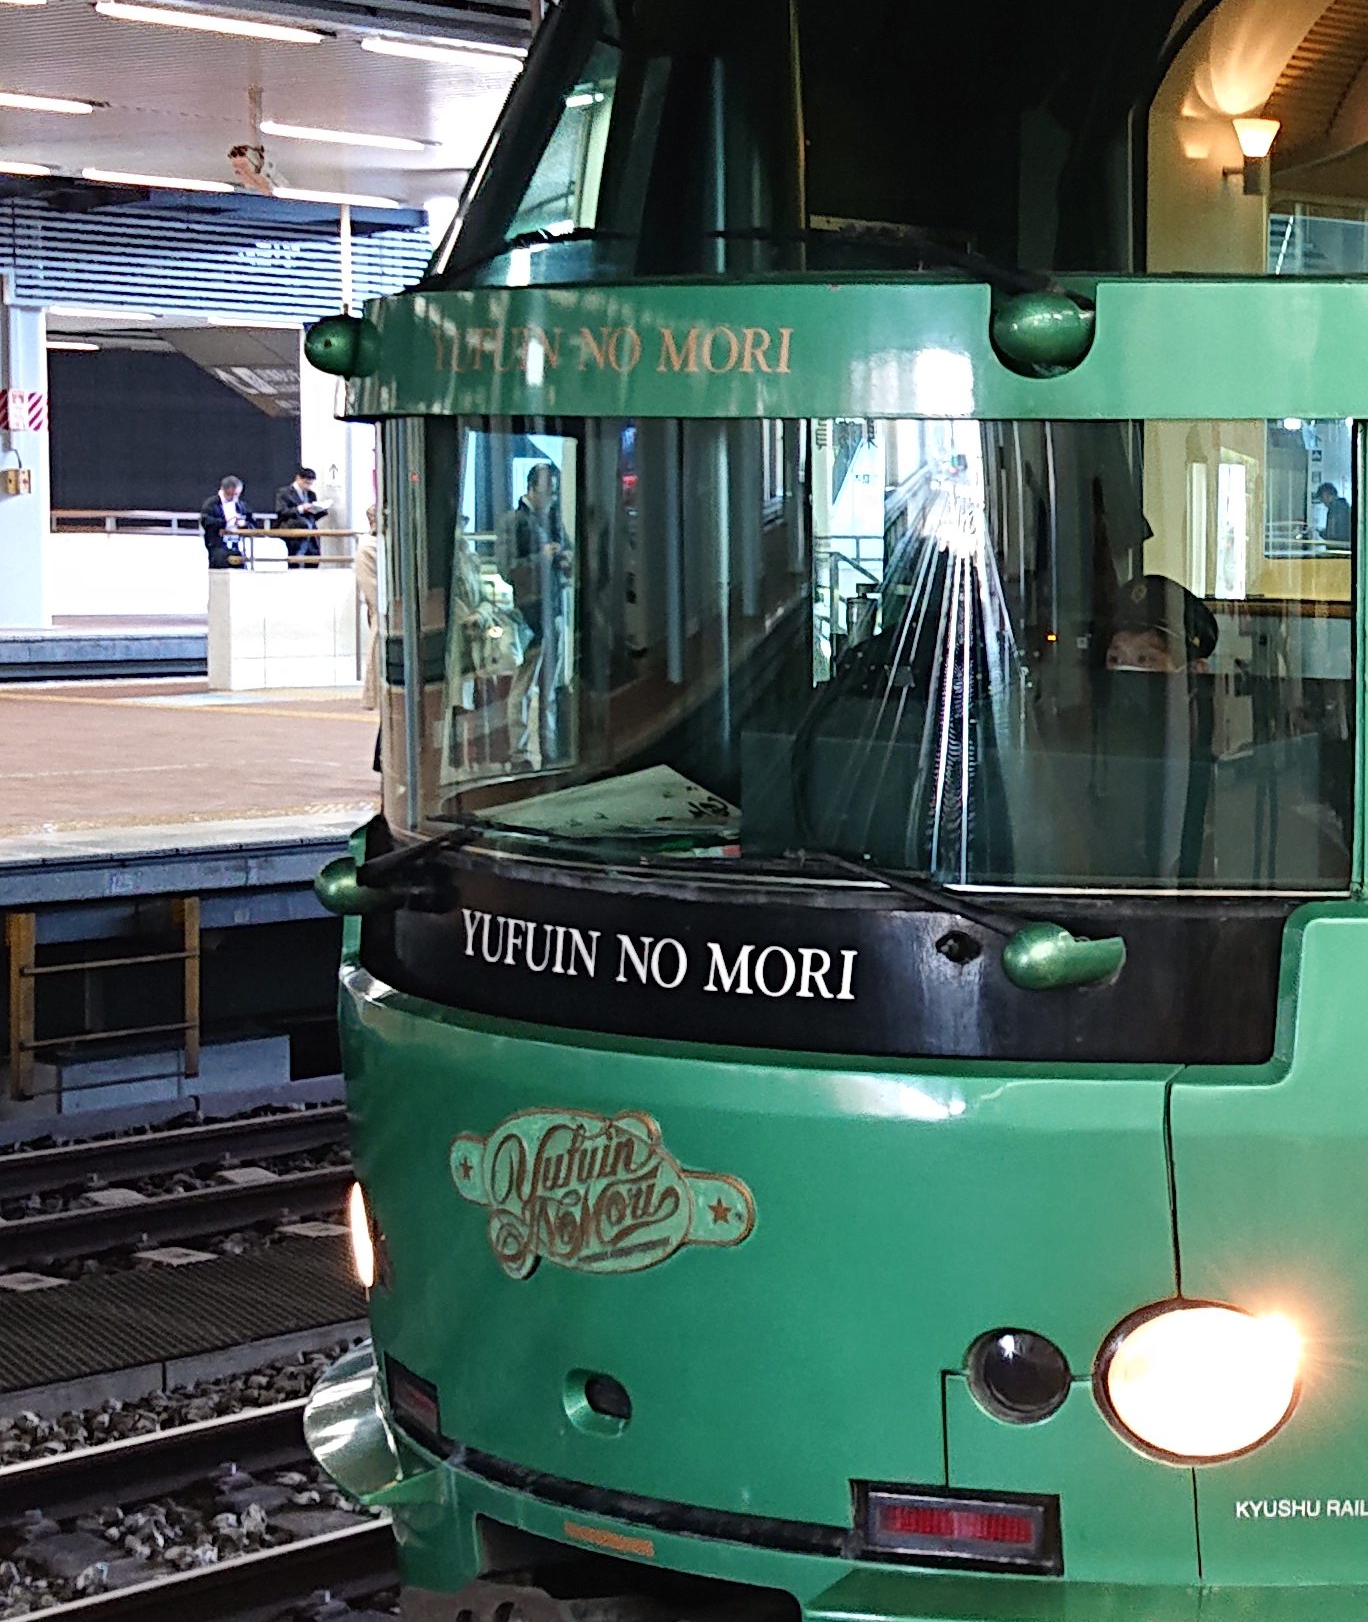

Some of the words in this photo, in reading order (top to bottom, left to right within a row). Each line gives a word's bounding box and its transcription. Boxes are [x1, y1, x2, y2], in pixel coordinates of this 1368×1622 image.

[578, 327, 641, 373] NO
[656, 326, 794, 374] MORI
[461, 908, 602, 978] YUFUIN
[615, 934, 688, 989] NO
[703, 942, 858, 1000] MORI
[492, 1123, 656, 1207] Yufuin
[1235, 1499, 1321, 1519] KYUSHU
